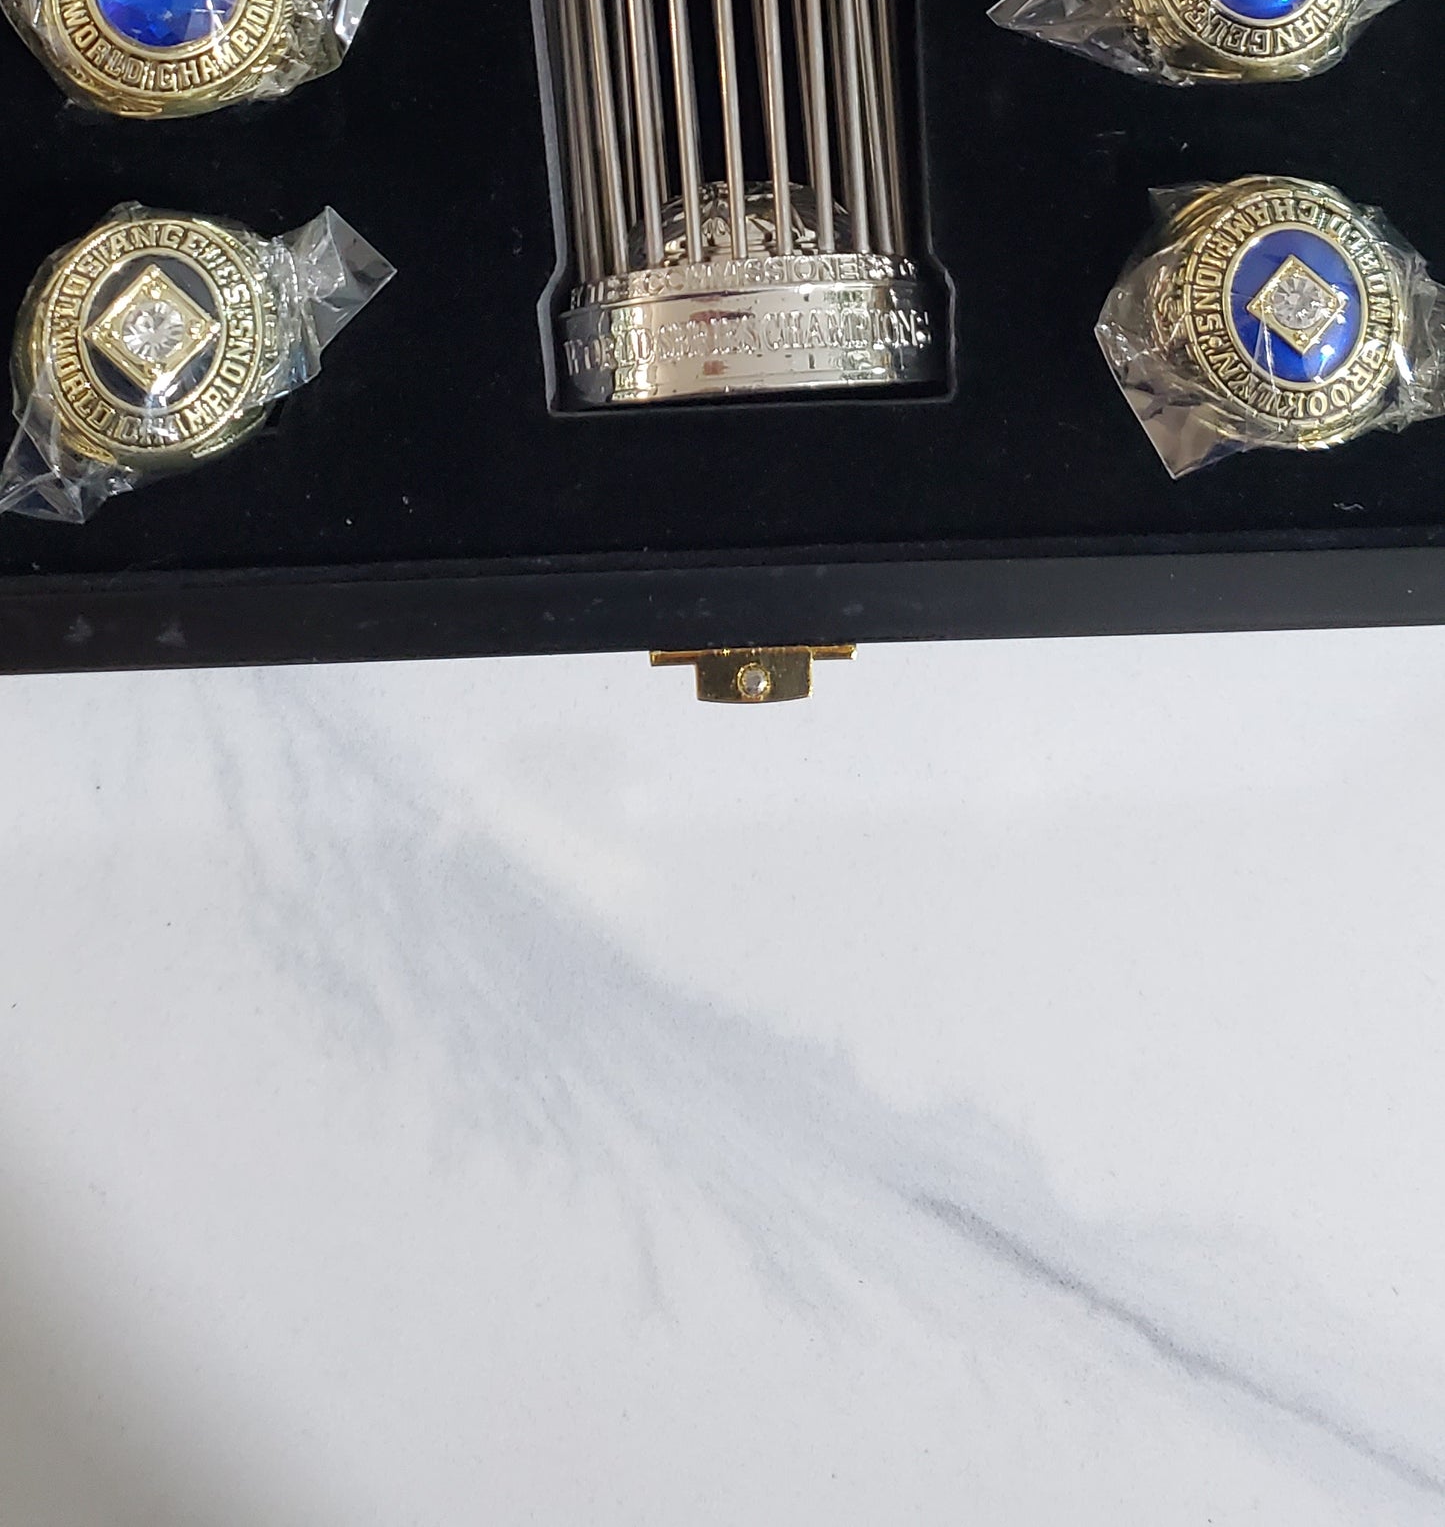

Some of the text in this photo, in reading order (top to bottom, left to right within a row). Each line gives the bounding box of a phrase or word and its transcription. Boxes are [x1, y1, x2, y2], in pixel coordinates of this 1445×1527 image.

[62, 1, 145, 84] WORLD
[110, 224, 250, 304] ANGELES
[1193, 198, 1320, 331] CHAMPIONS
[54, 332, 117, 430] WORLD
[1210, 343, 1386, 418] BROOKLYN
